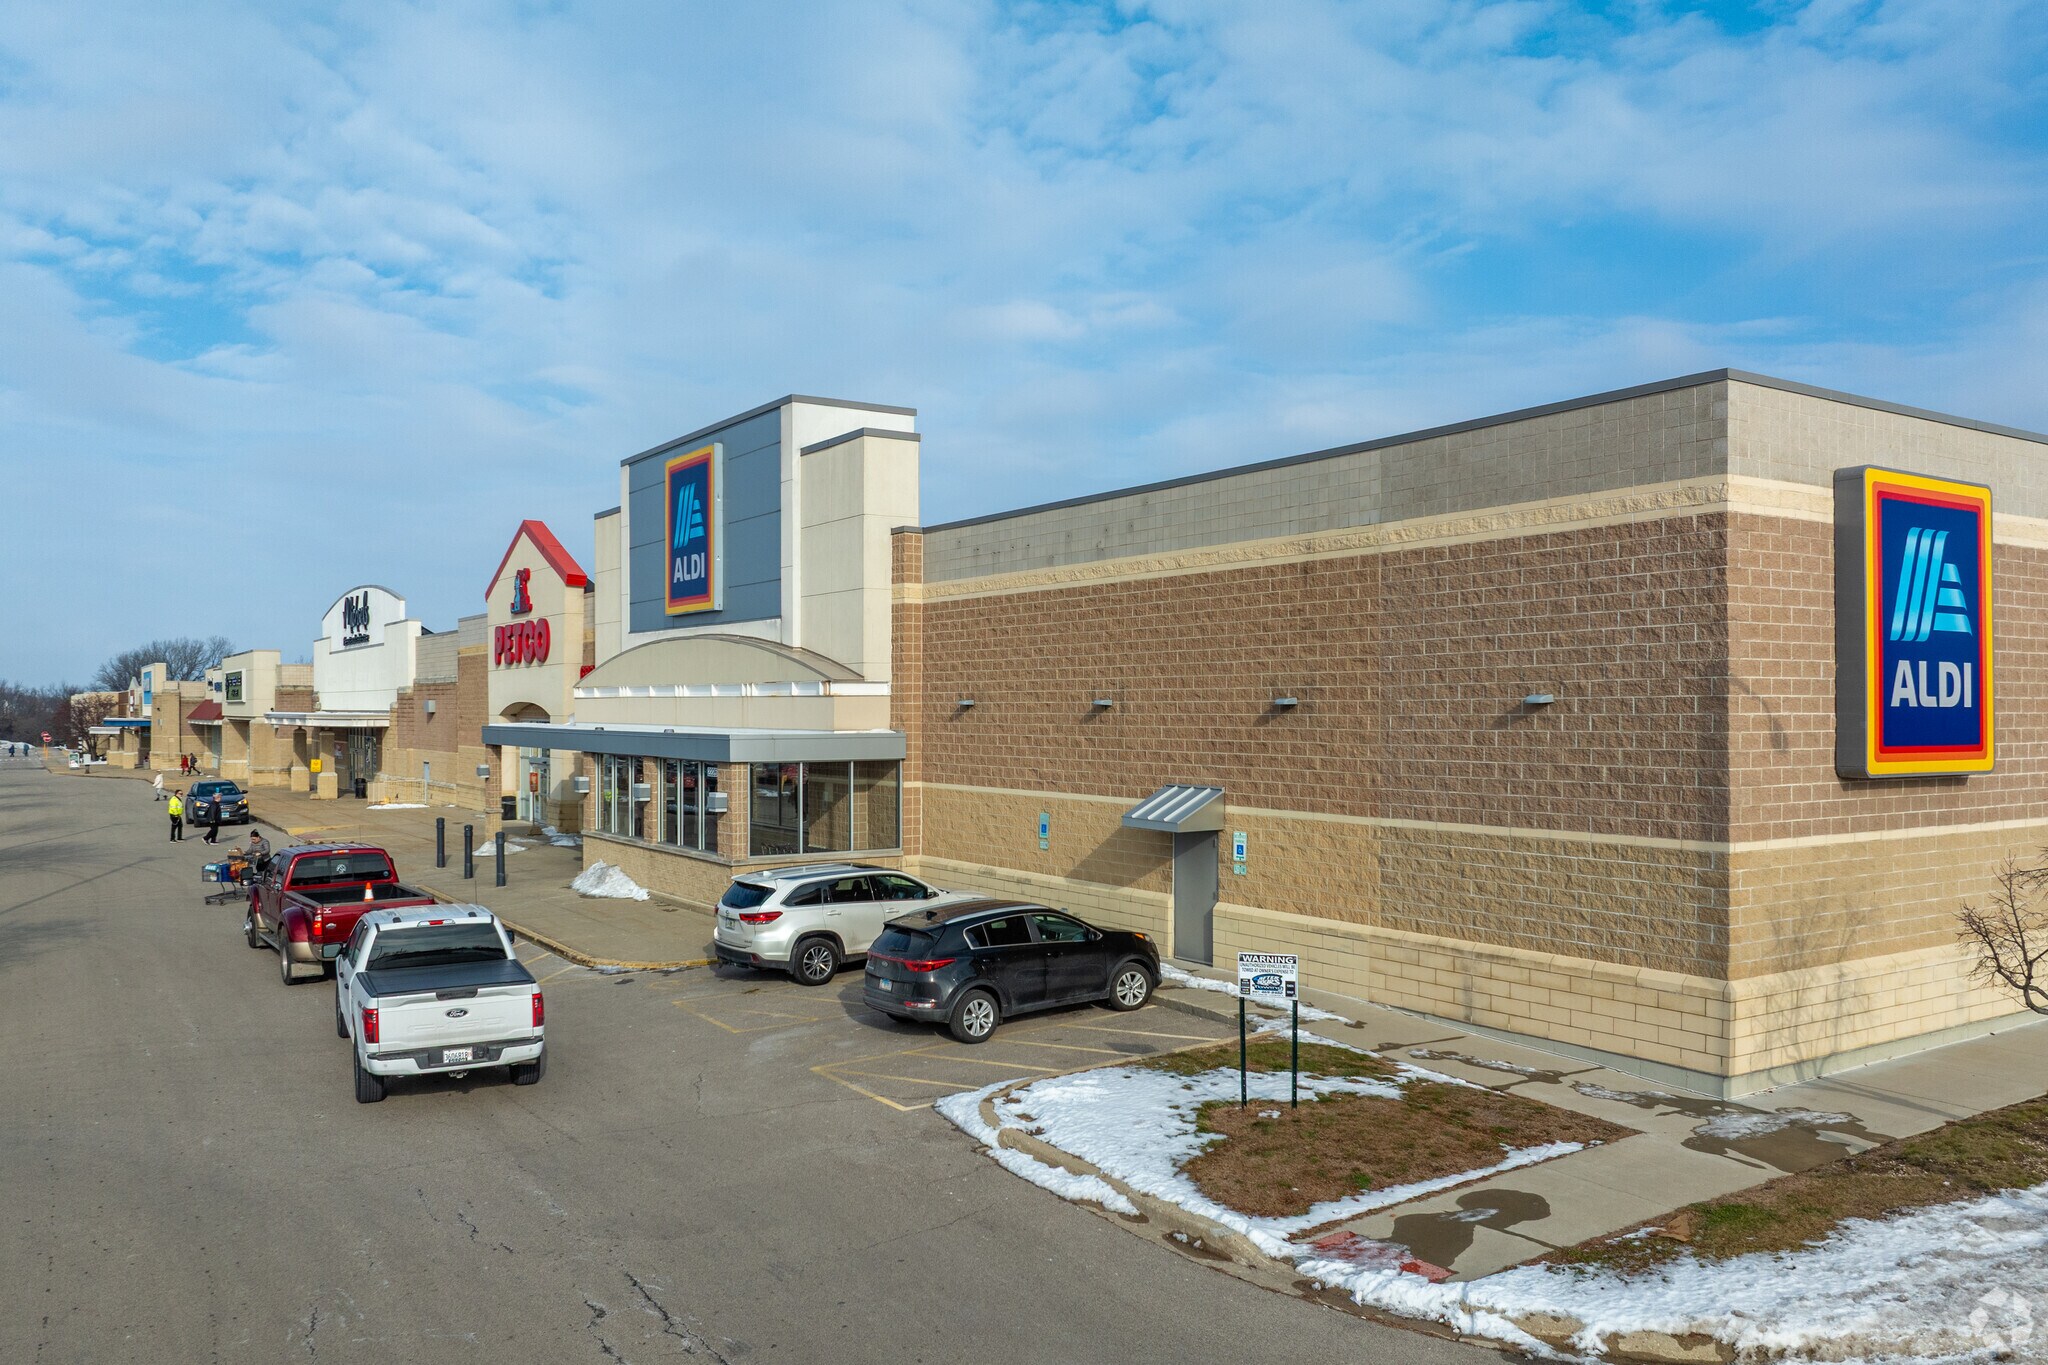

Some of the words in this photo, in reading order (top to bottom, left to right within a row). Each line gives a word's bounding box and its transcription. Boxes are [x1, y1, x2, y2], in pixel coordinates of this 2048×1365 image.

[673, 552, 705, 584] ALDI
[494, 617, 551, 667] PETCO
[1890, 659, 1973, 708] ALDI
[1242, 955, 1294, 964] WARNING
